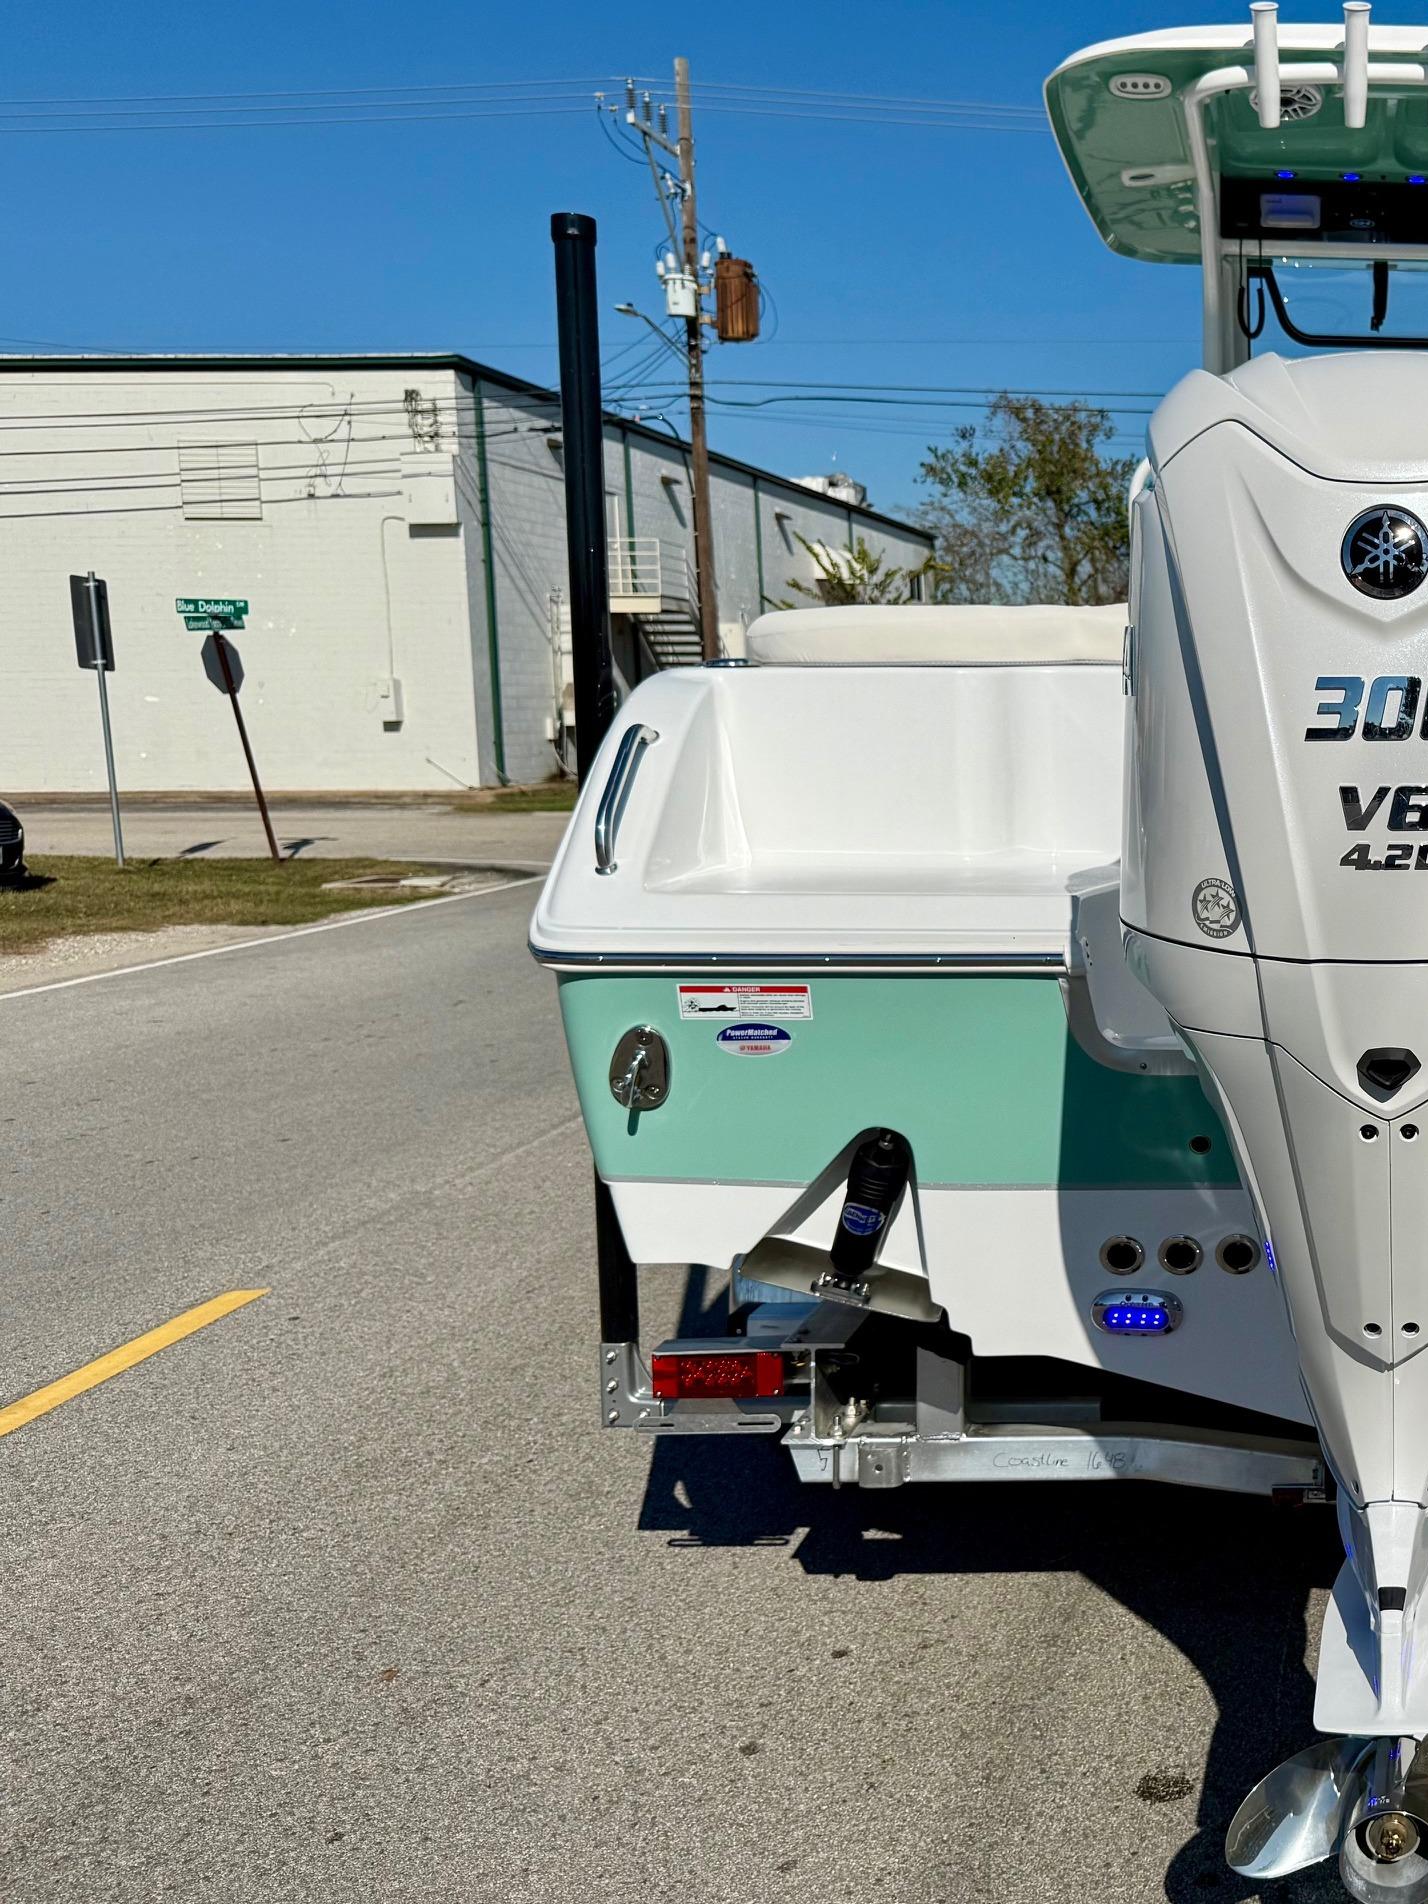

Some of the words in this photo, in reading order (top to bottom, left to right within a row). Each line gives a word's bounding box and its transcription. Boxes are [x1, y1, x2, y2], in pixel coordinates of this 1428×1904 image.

[177, 600, 194, 612] Blue
[199, 601, 234, 613] Dolphin
[726, 1029, 777, 1037] PowerMatched
[747, 1044, 772, 1052] YAMAHA
